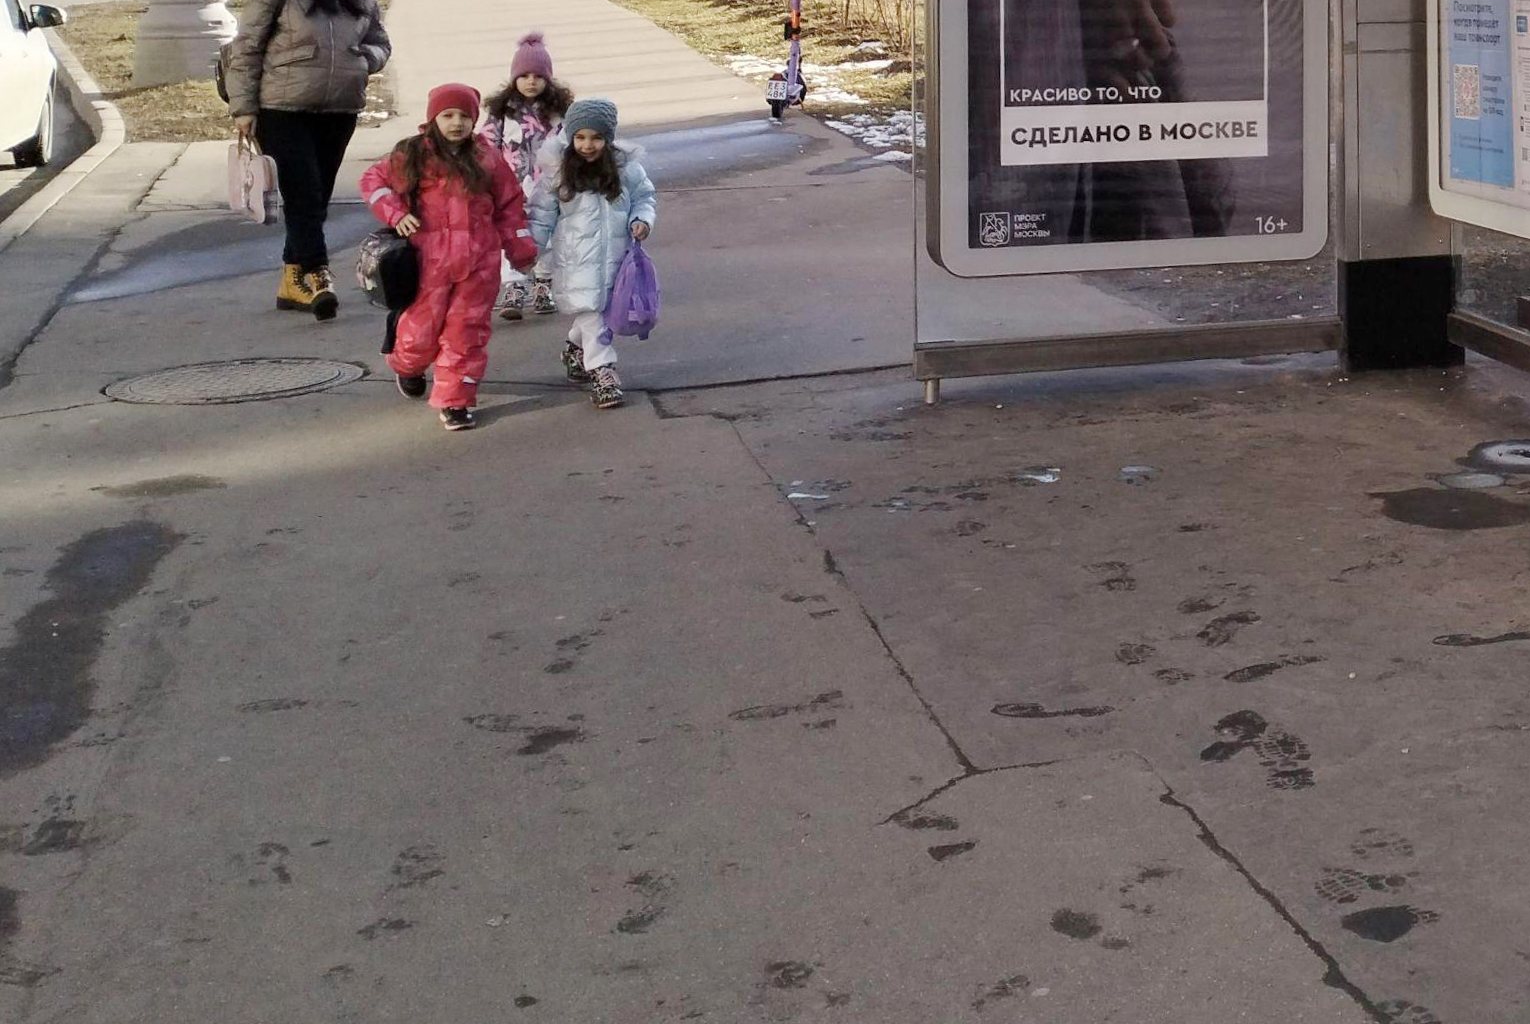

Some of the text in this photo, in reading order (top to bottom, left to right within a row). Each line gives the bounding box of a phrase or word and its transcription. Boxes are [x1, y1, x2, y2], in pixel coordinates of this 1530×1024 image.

[1009, 85, 1162, 103] КРАСИВО ТО, ЧТО
[1010, 120, 1259, 148] СДЕЛАНО В МОСКВЕ
[1254, 215, 1289, 234] 16+
